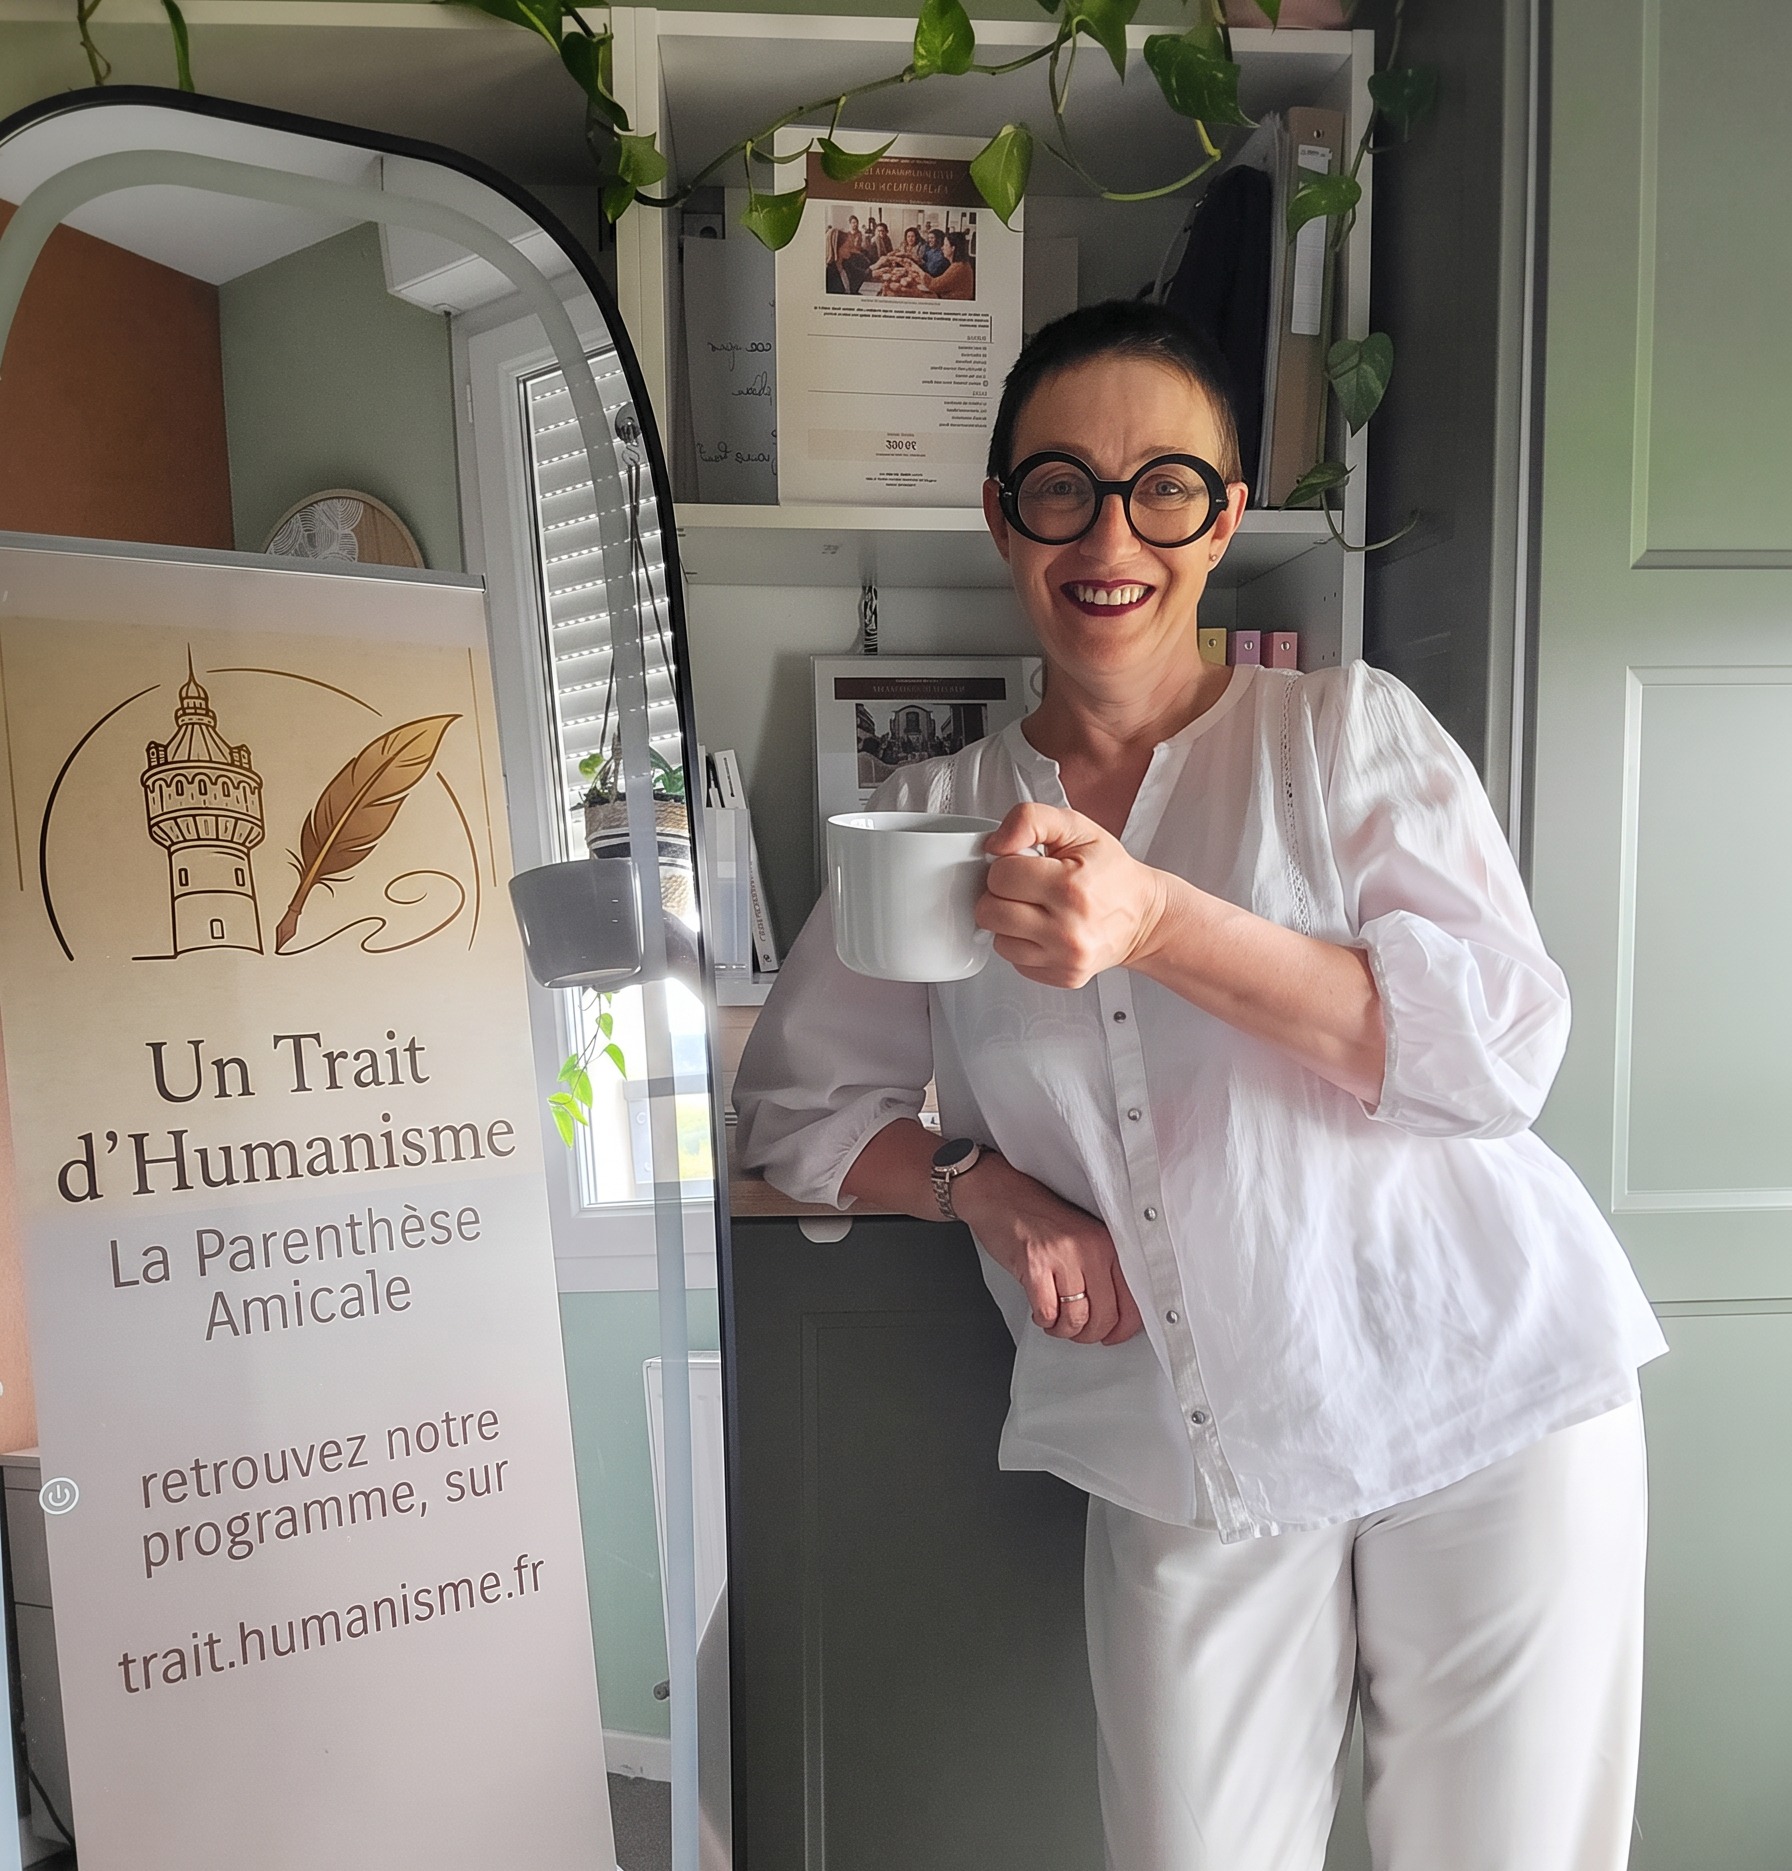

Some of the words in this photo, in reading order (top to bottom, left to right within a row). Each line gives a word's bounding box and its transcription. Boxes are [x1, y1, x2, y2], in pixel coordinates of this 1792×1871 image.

[145, 1039, 256, 1104] Un
[273, 1029, 430, 1093] Trait
[57, 1112, 516, 1203] d’Humanisme
[110, 1240, 171, 1288] La
[196, 1204, 481, 1277] Parenthèse
[205, 1269, 412, 1341] Amicale
[141, 1434, 369, 1509] retrouvez
[387, 1410, 500, 1460] notre
[142, 1481, 428, 1579] programme,
[445, 1460, 509, 1503] sur
[118, 1553, 545, 1694] trait.humanisme.fr
